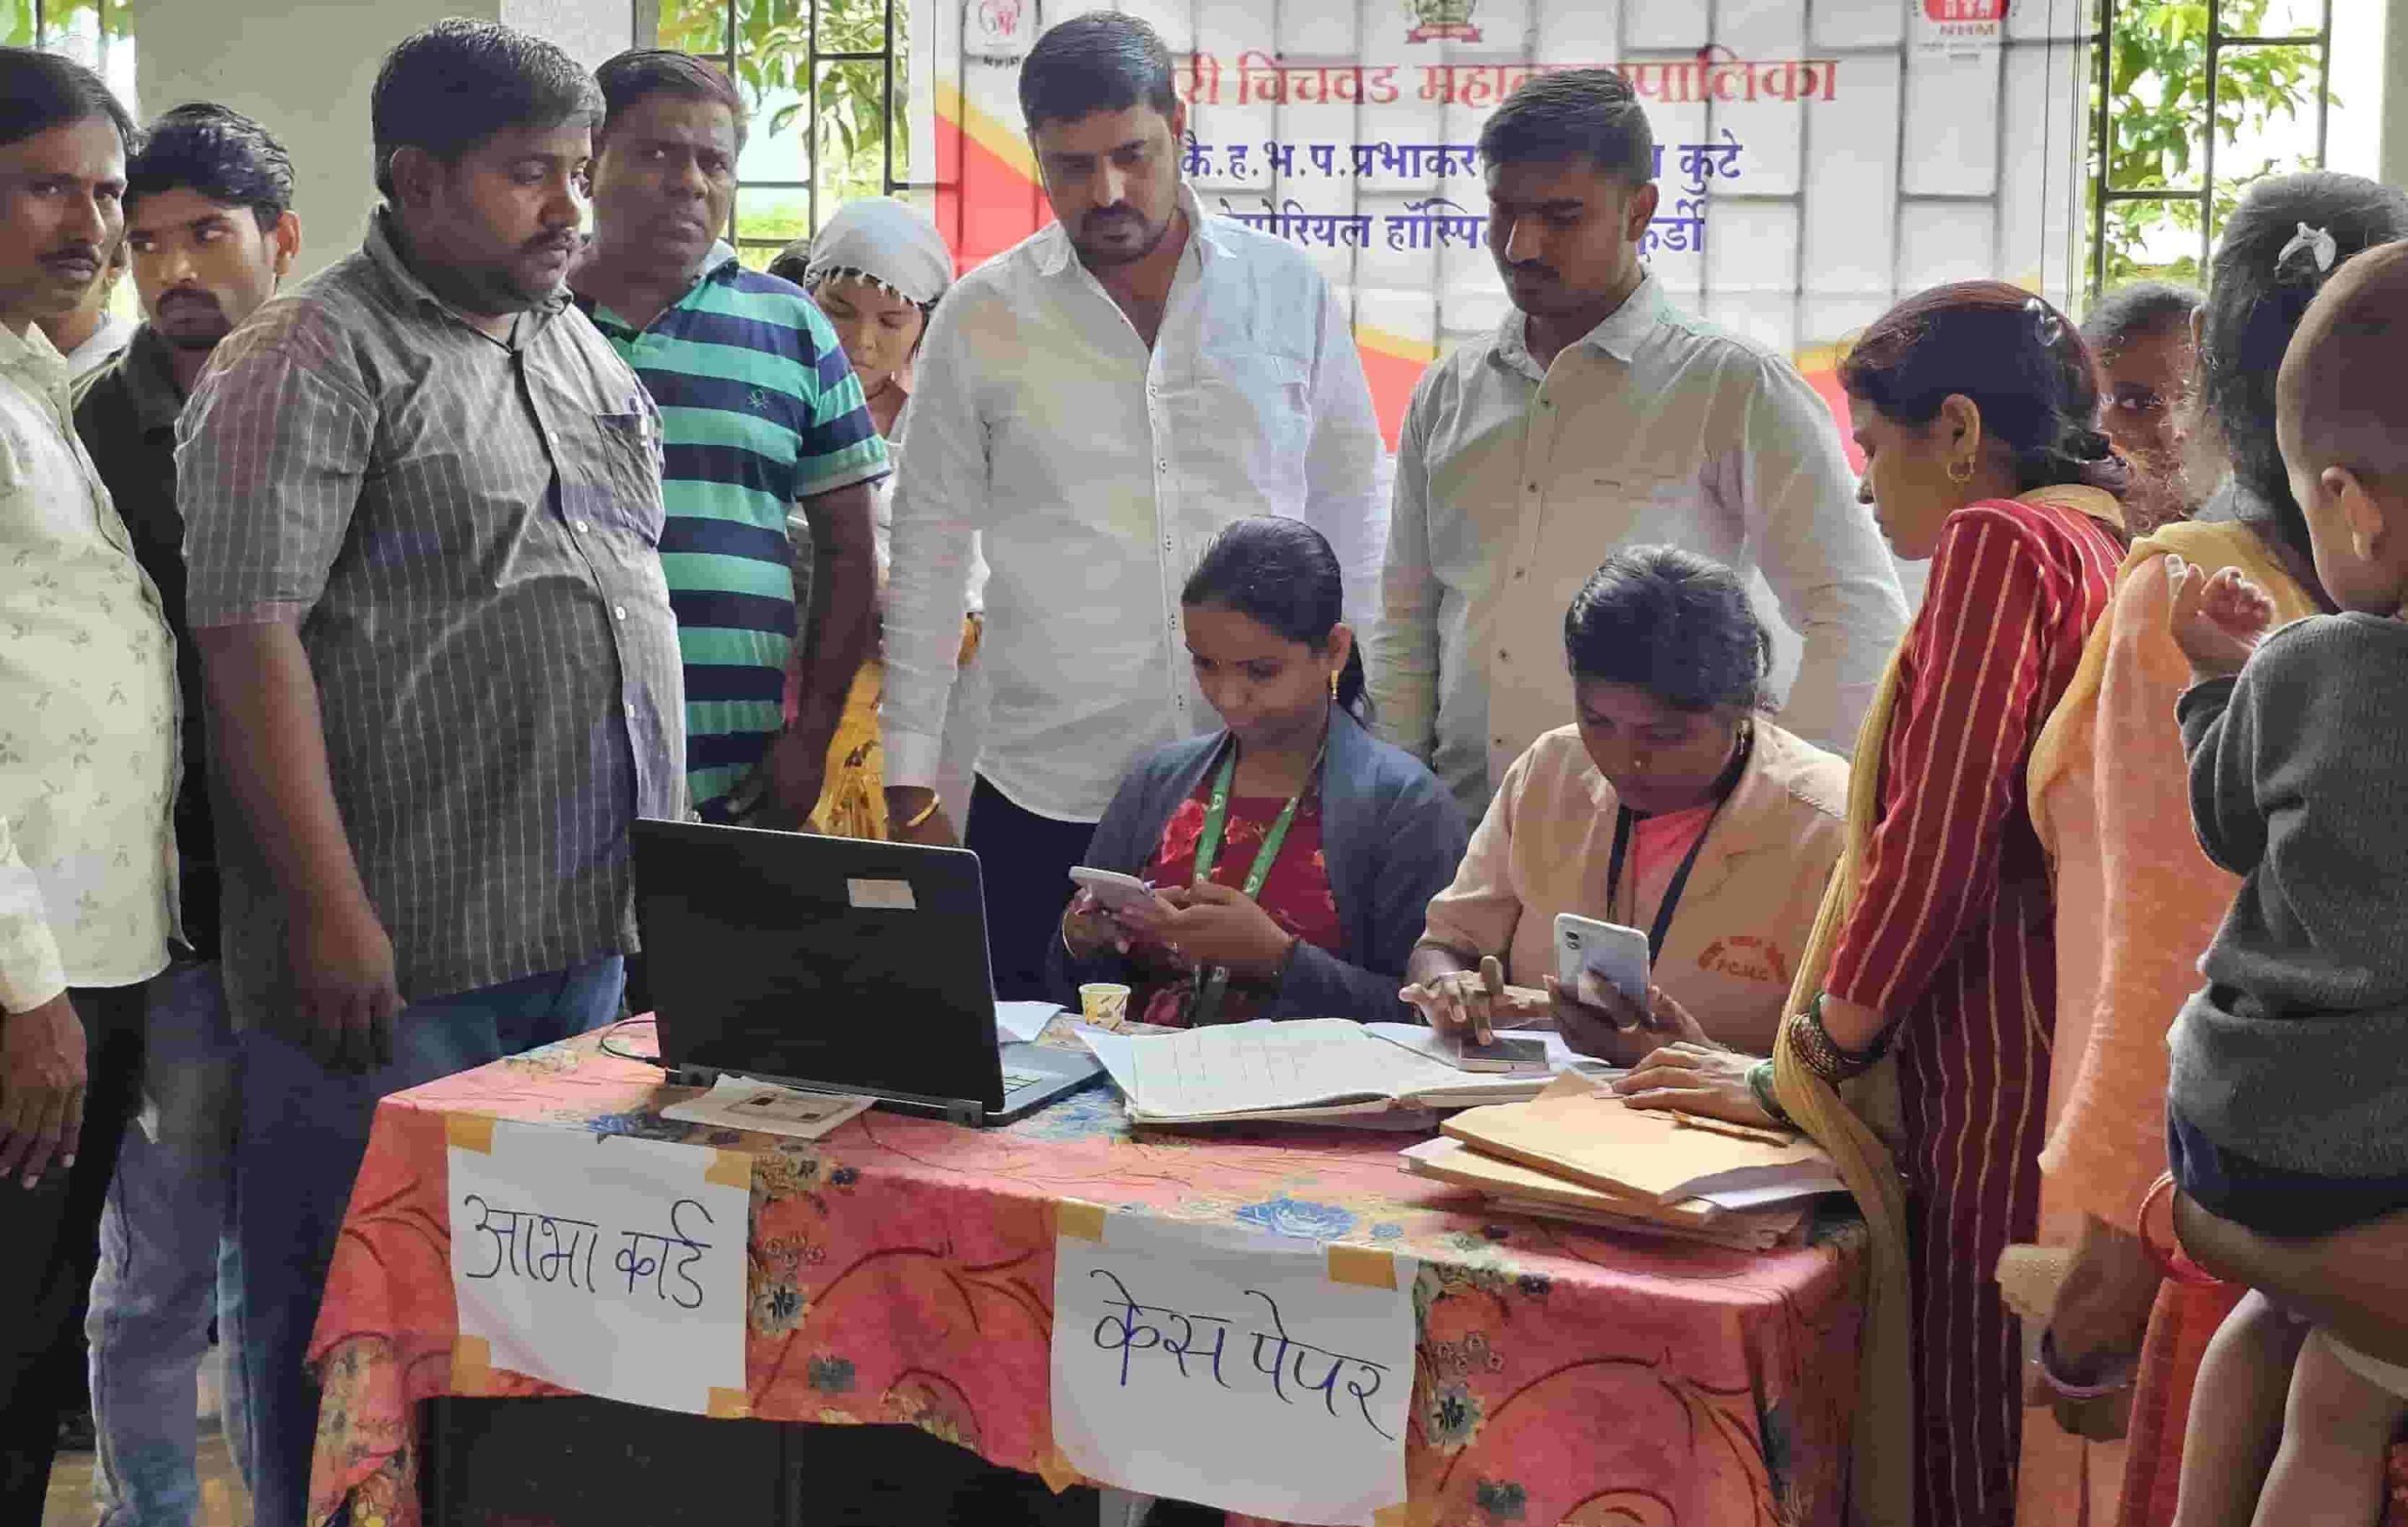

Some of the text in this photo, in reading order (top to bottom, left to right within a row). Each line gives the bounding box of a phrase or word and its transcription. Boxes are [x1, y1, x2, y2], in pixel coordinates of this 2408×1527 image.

[1678, 128, 1743, 196] कुटे
[464, 1193, 715, 1309] आभा कार्ड
[1088, 1268, 1396, 1442] केस पेपर
